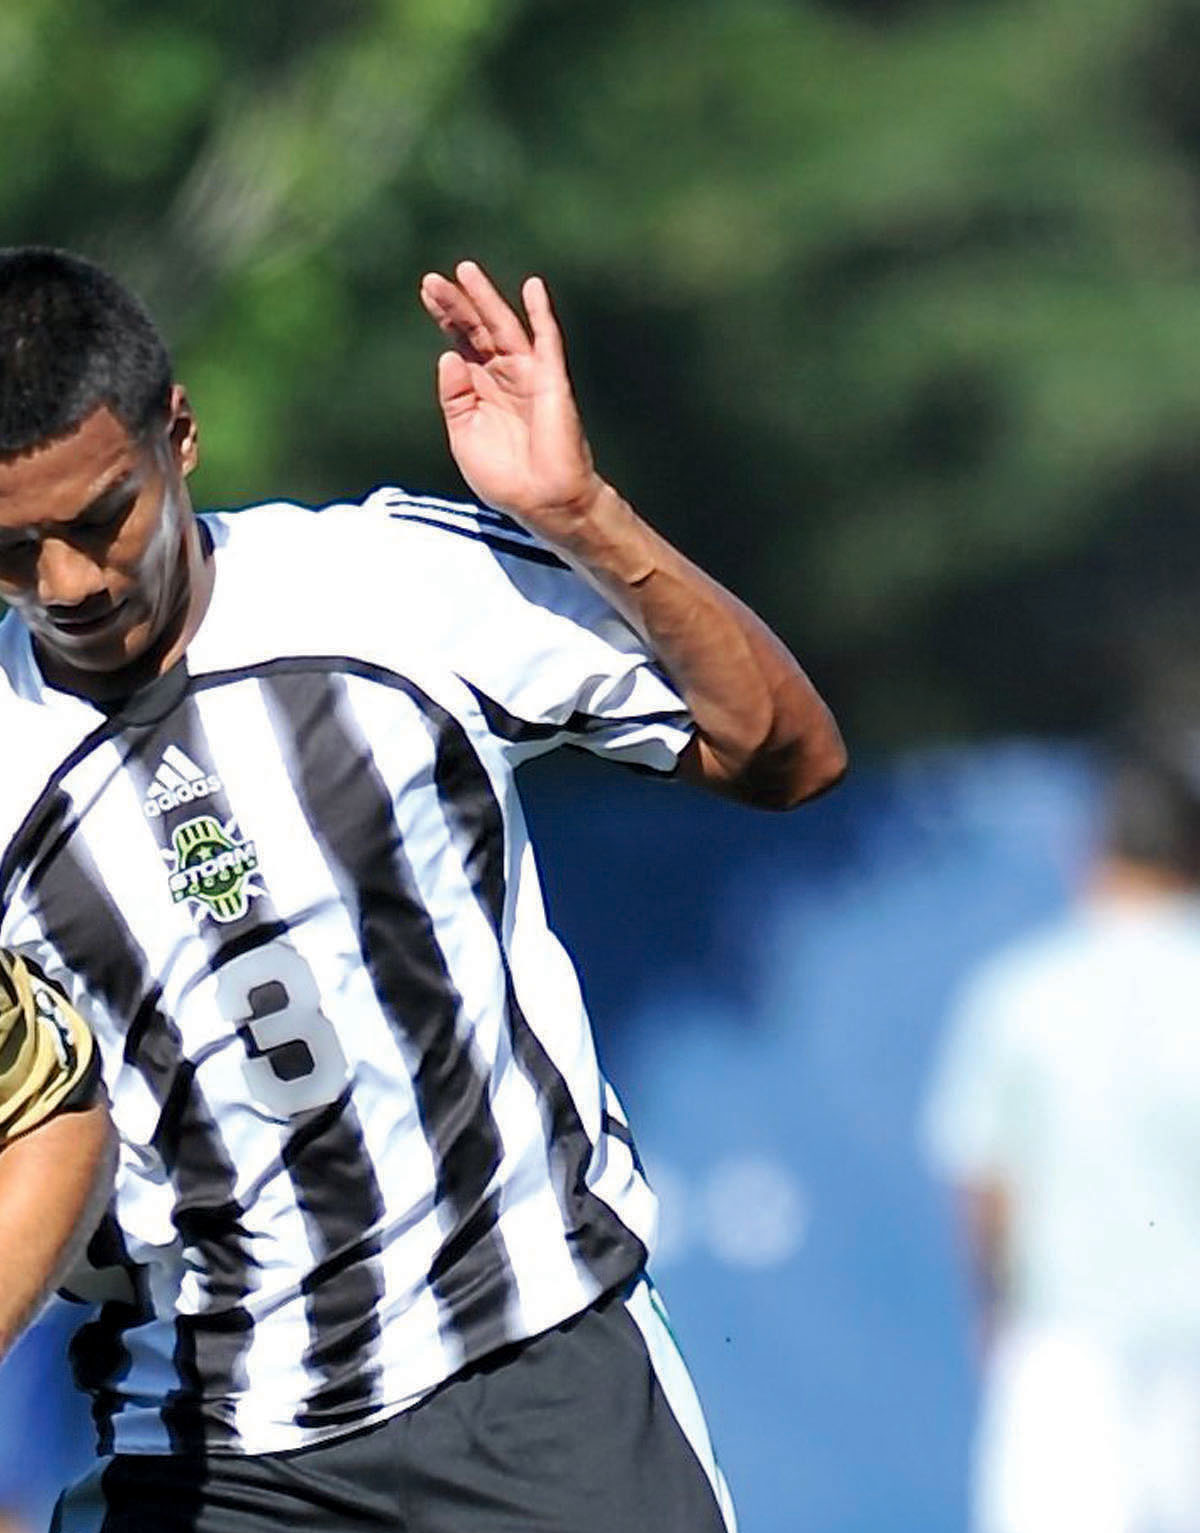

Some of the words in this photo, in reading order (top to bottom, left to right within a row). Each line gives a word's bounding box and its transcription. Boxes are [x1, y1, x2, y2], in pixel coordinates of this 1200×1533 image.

[144, 775, 221, 817] adidas
[169, 842, 257, 892] STORM
[215, 940, 348, 1118] 3
